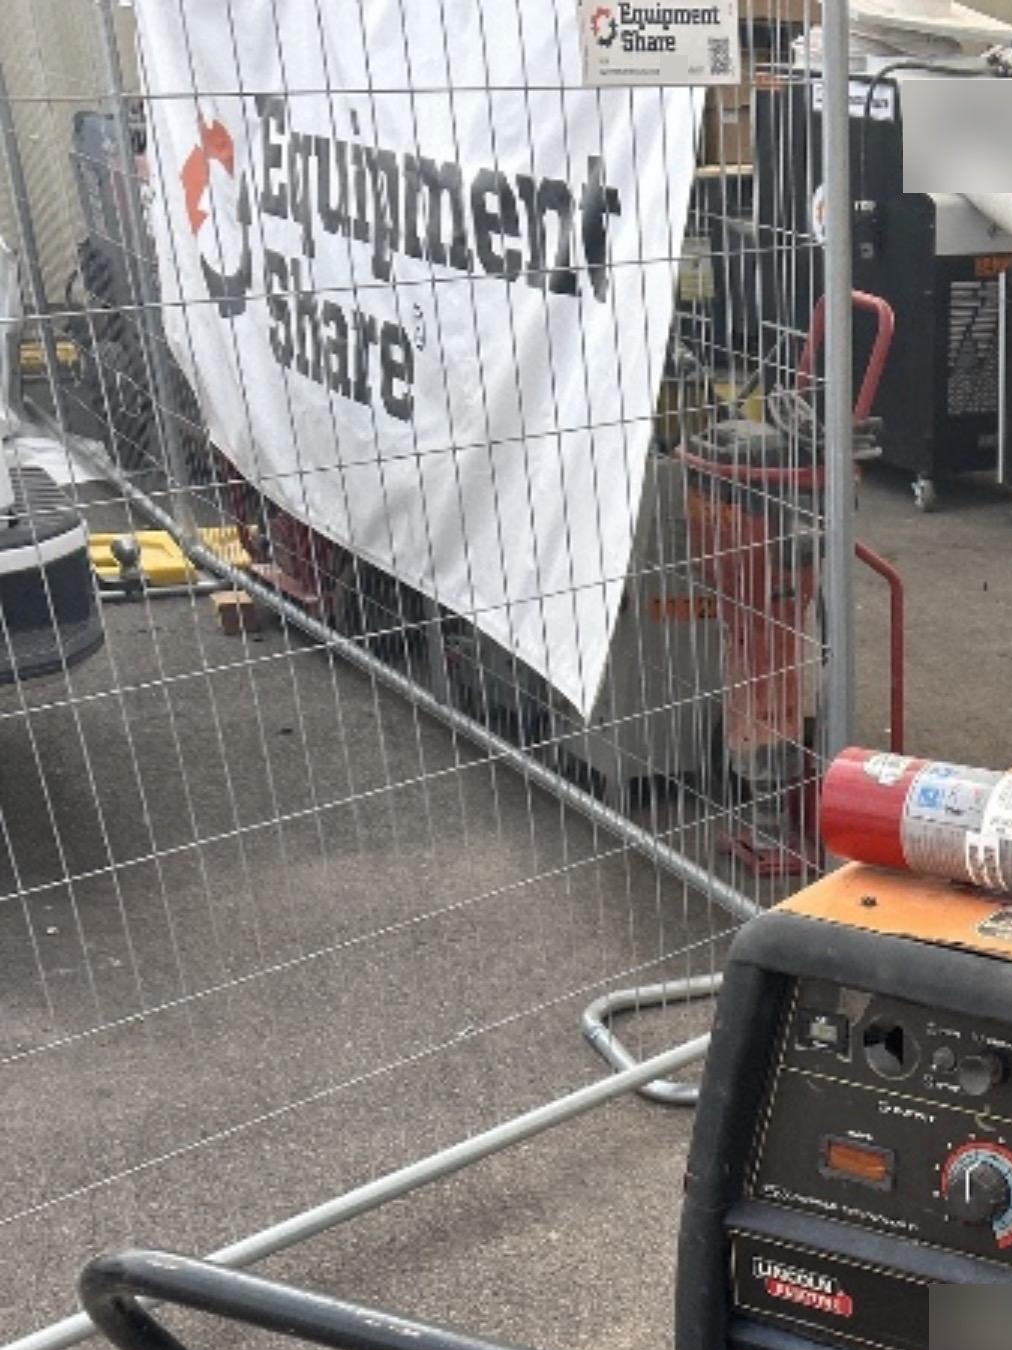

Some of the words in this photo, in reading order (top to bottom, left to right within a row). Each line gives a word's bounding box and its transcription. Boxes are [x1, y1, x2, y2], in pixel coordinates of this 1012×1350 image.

[618, 2, 720, 30] Equipment
[621, 30, 676, 52] Share
[254, 95, 621, 303] Equipment
[264, 248, 415, 422] Share
[752, 1256, 837, 1294] LINCOLN
